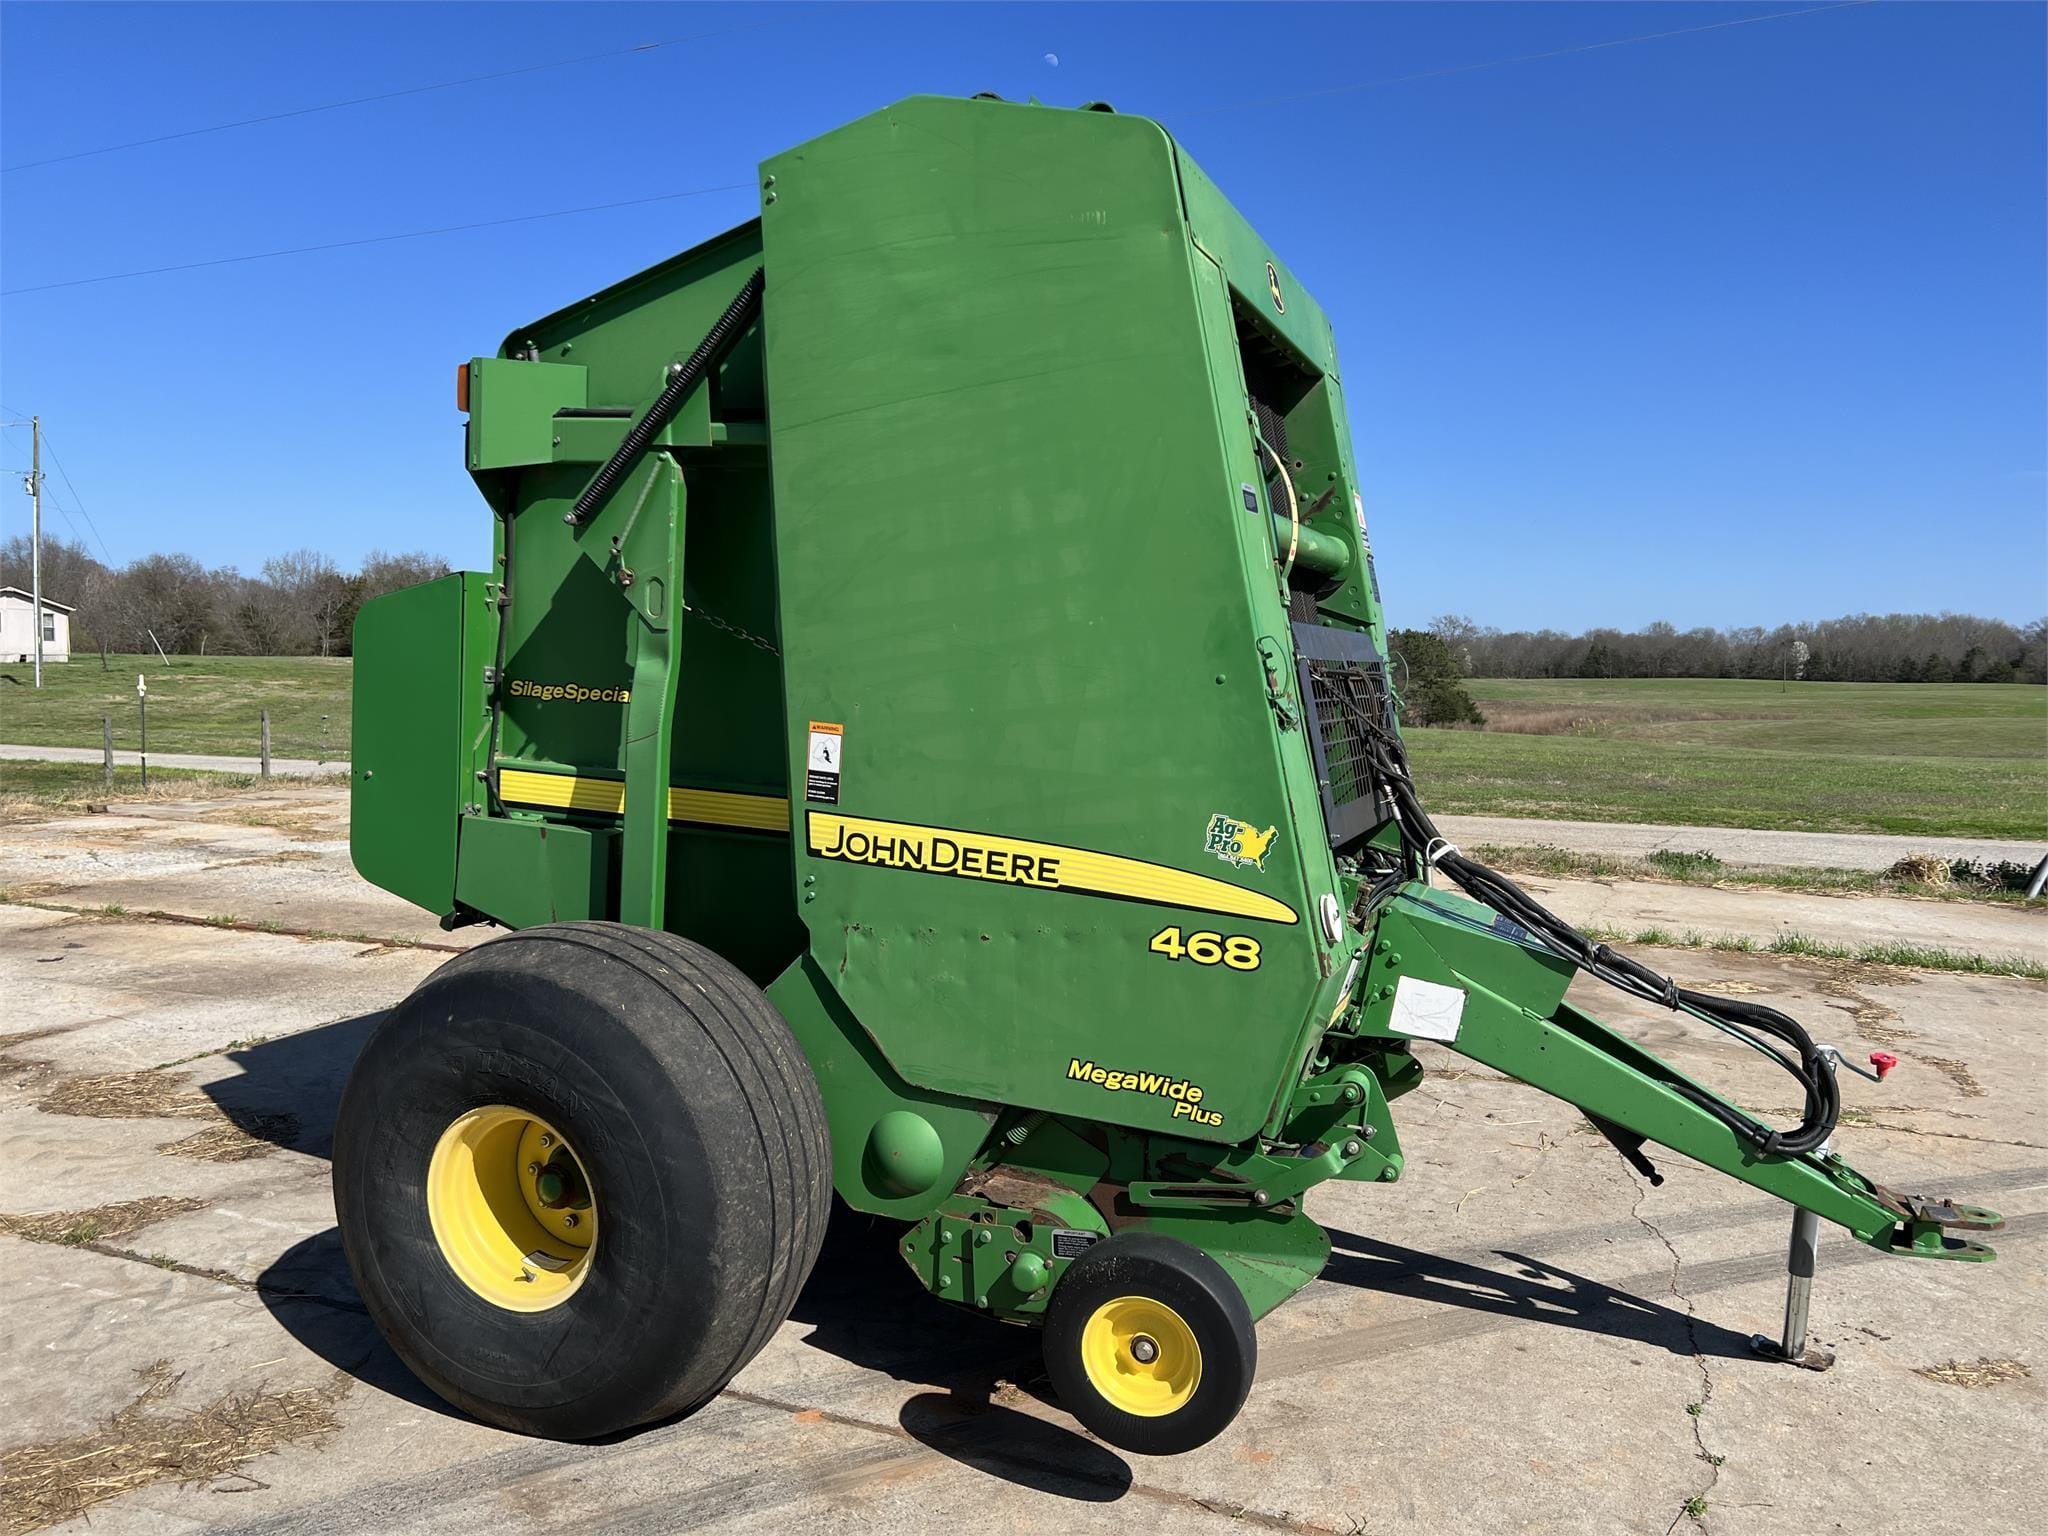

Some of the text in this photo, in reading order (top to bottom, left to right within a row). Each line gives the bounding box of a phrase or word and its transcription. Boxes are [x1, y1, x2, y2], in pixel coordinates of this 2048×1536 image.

[825, 825, 1060, 884] JOHN DEERE
[1207, 833, 1242, 853] Pro
[1149, 925, 1262, 971] 468
[475, 1048, 592, 1118] TITAN
[1066, 1058, 1204, 1103] MegaWide
[1171, 1101, 1225, 1127] Plus
